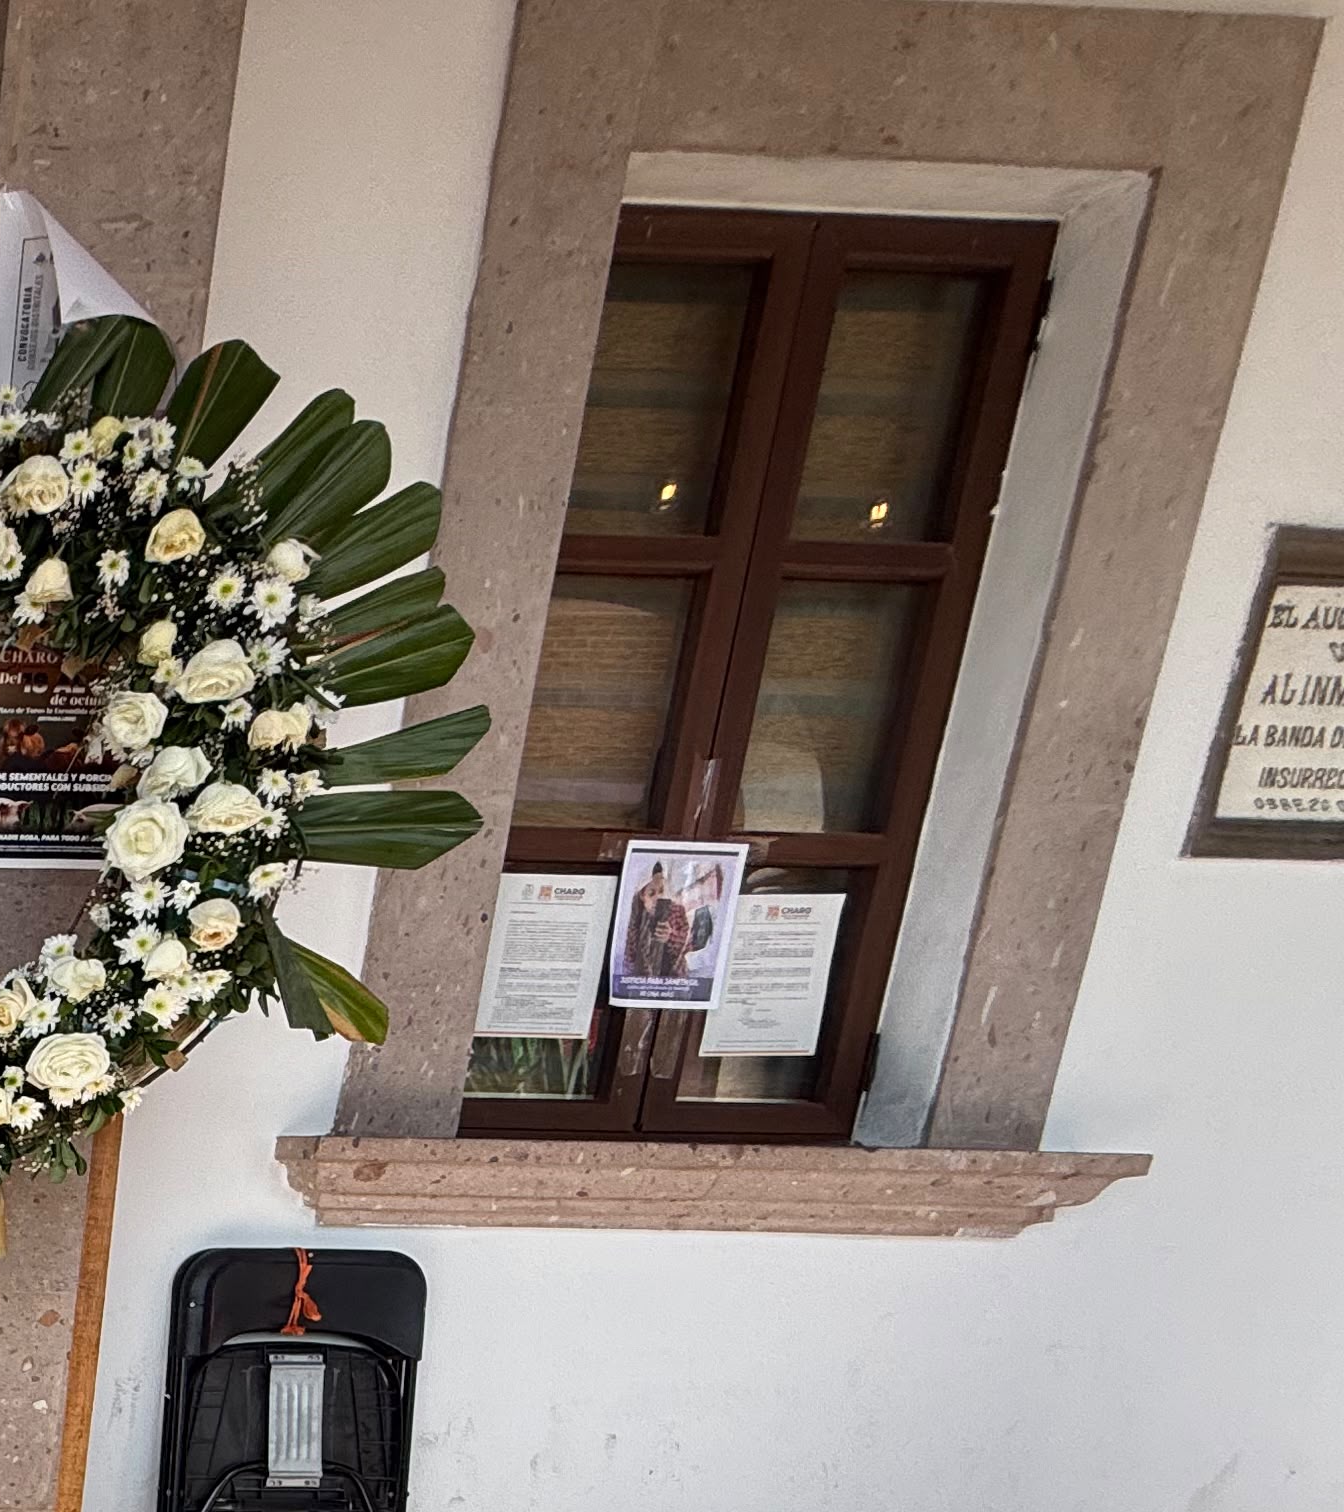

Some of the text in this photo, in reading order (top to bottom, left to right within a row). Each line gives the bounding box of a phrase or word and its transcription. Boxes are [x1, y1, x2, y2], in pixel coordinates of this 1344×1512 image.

[18, 287, 32, 362] CONVOCATORIA
[1268, 604, 1299, 628] EL
[0, 672, 22, 684] Del
[1260, 673, 1298, 705] AL
[50, 694, 67, 706] de
[1231, 724, 1260, 746] LA
[1264, 724, 1326, 748] BANDA
[9, 772, 69, 782] SEMENTALES
[51, 783, 71, 792] CON
[554, 887, 585, 895] CHARO
